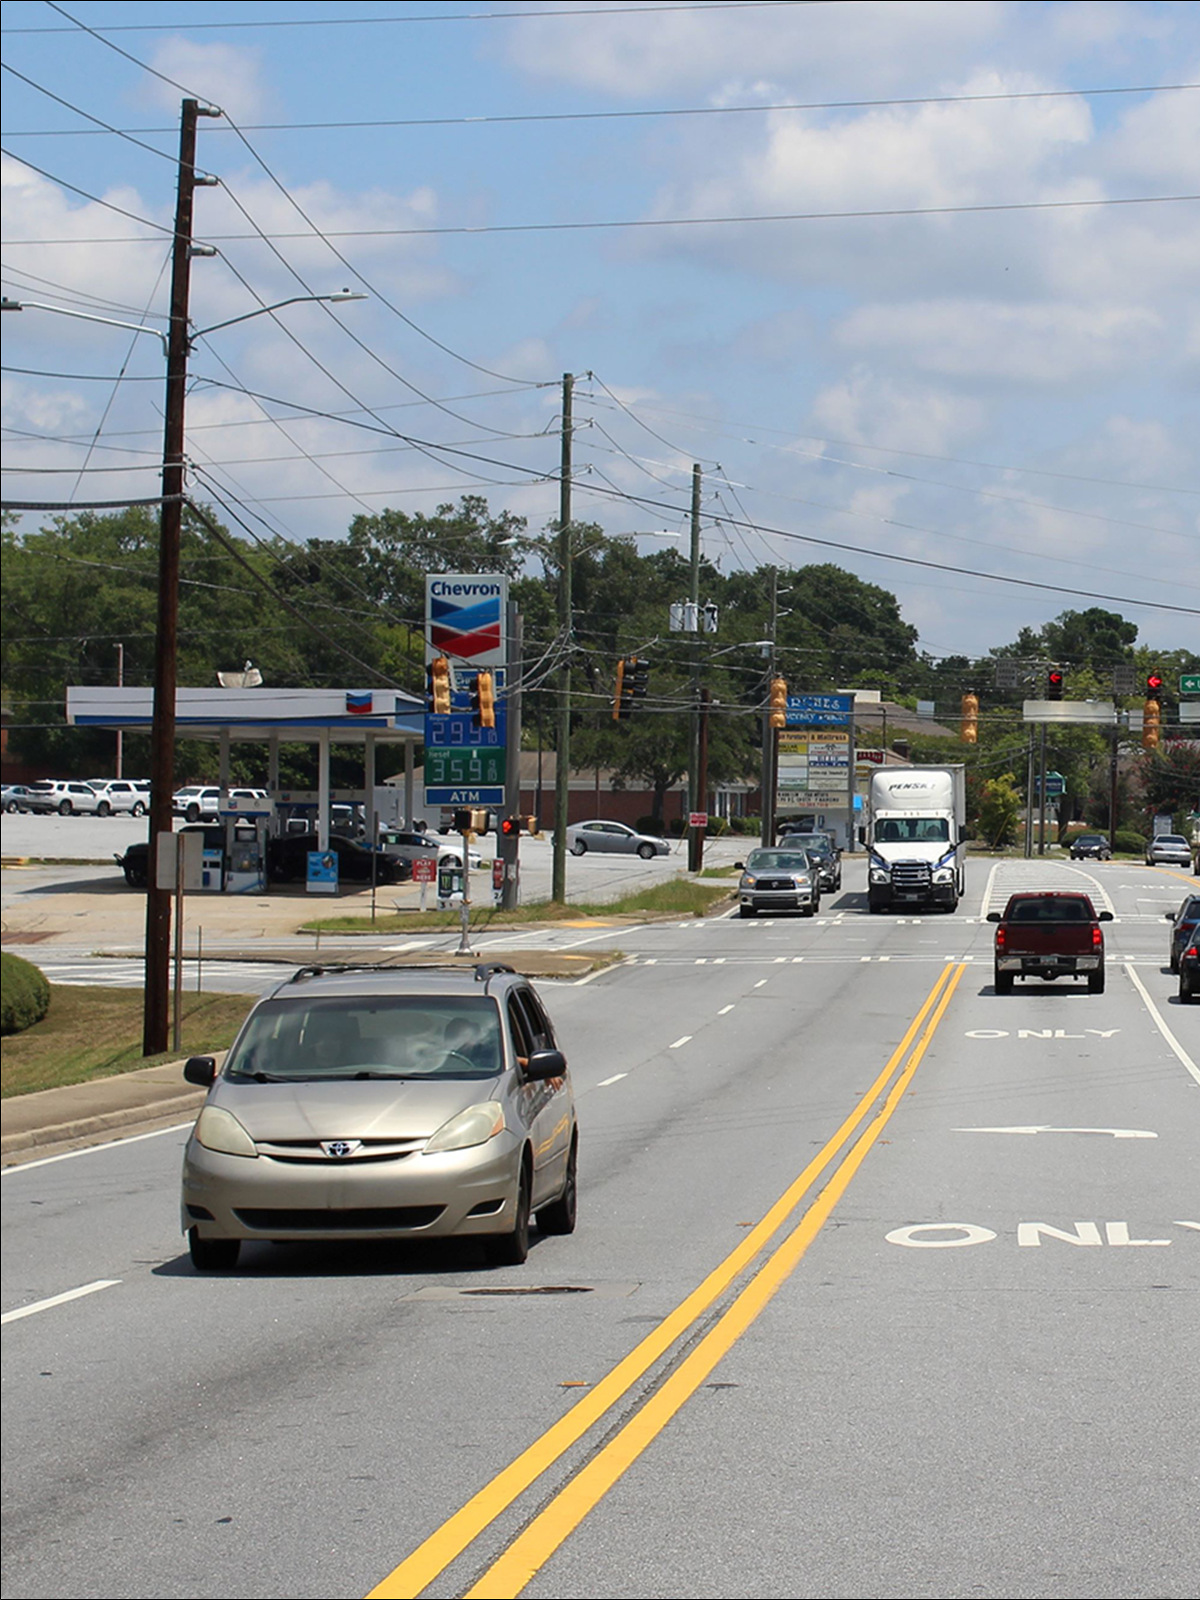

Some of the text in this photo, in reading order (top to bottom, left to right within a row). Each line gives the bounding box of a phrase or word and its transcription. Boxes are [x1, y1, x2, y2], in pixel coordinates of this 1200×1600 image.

[431, 581, 501, 596] Chevron
[432, 759, 482, 782] 359
[450, 791, 480, 802] ATM
[964, 1029, 1121, 1039] ONLY
